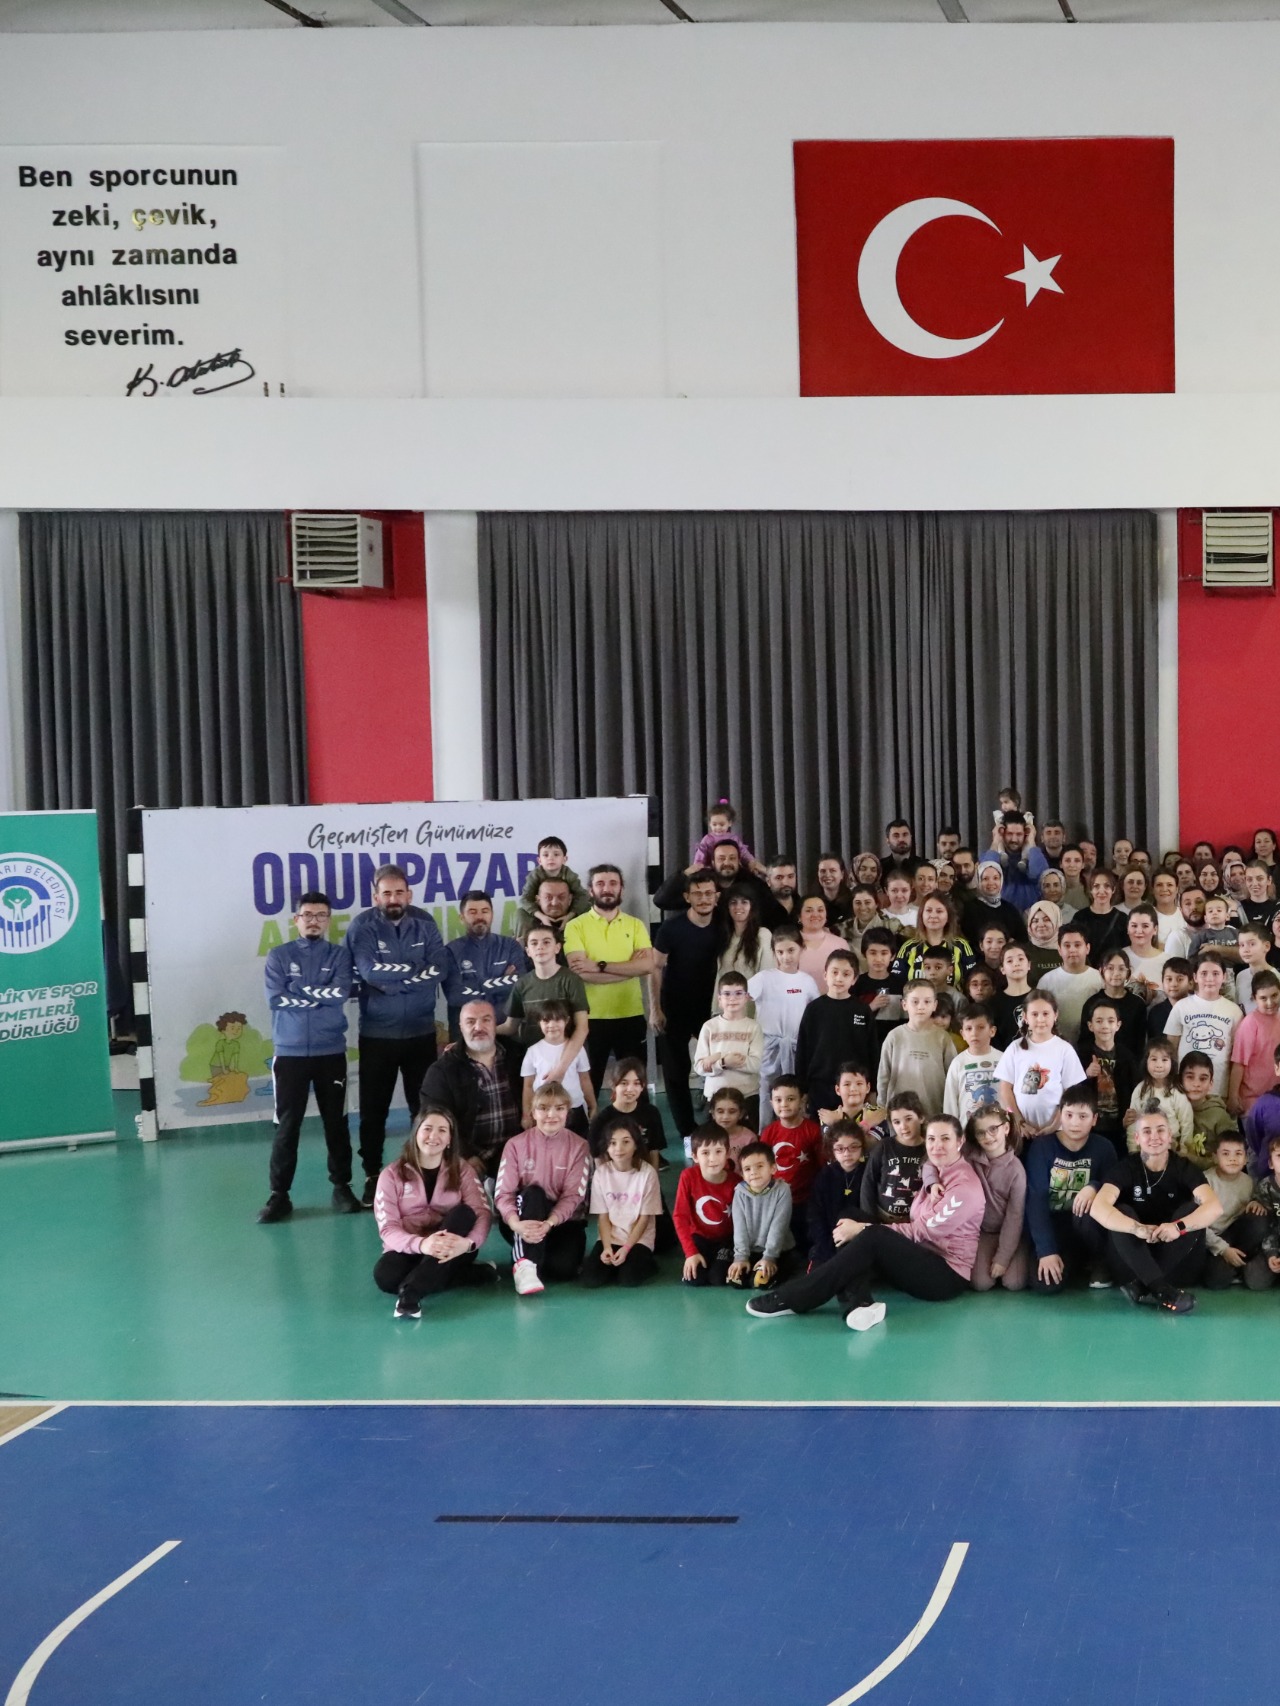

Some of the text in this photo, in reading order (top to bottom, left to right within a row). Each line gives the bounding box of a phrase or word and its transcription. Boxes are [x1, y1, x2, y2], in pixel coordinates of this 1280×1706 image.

[18, 165, 238, 193] Ben sporcunun
[51, 202, 217, 231] zeki, çevik,
[36, 243, 238, 273] aynı zamanda
[61, 283, 200, 306] ahlâklısını
[64, 323, 185, 346] severim.
[307, 819, 515, 851] Geçmişten Günümüze
[252, 851, 539, 917] ODUNPAZAR
[27, 988, 48, 1001] VE
[50, 981, 97, 999] SPOR
[1183, 1012, 1232, 1026] Cinnamoroll
[902, 1156, 921, 1165] TIME
[1053, 1156, 1092, 1168] MINECRAFT
